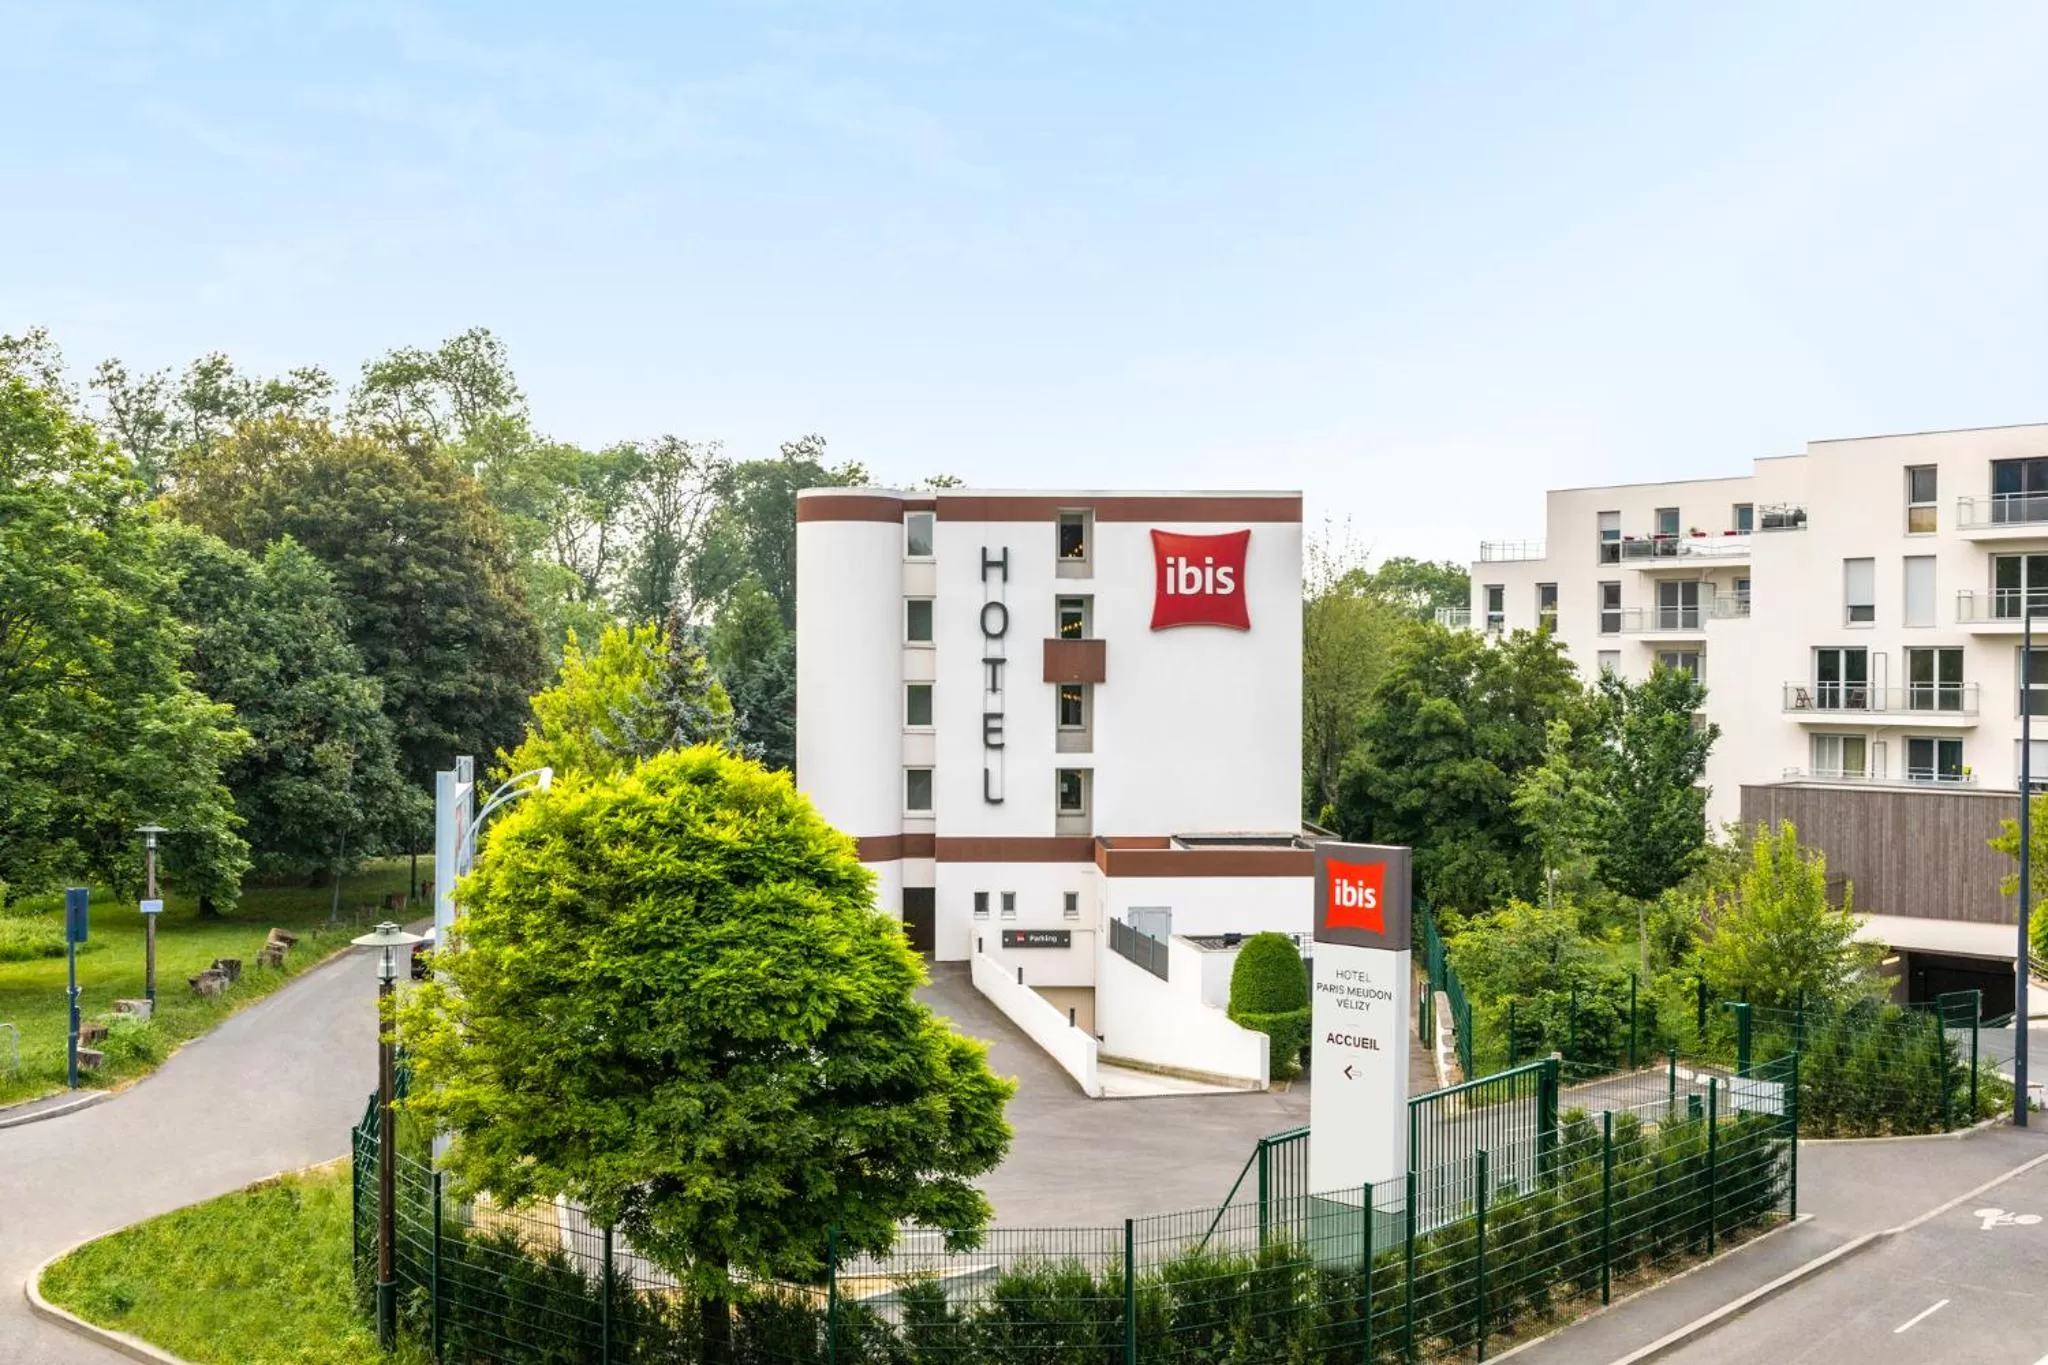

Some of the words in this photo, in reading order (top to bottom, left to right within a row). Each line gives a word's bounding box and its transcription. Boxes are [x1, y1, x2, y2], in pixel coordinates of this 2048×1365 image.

[1166, 556, 1235, 595] ibis
[980, 546, 1009, 804] HOTEL
[1335, 878, 1376, 909] ibis
[1029, 934, 1057, 943] Parking
[1336, 968, 1371, 983] HOTEL
[1316, 982, 1345, 995] PARIS
[1347, 986, 1392, 1001] MEUDON
[1326, 1032, 1380, 1051] ACCUEIL
